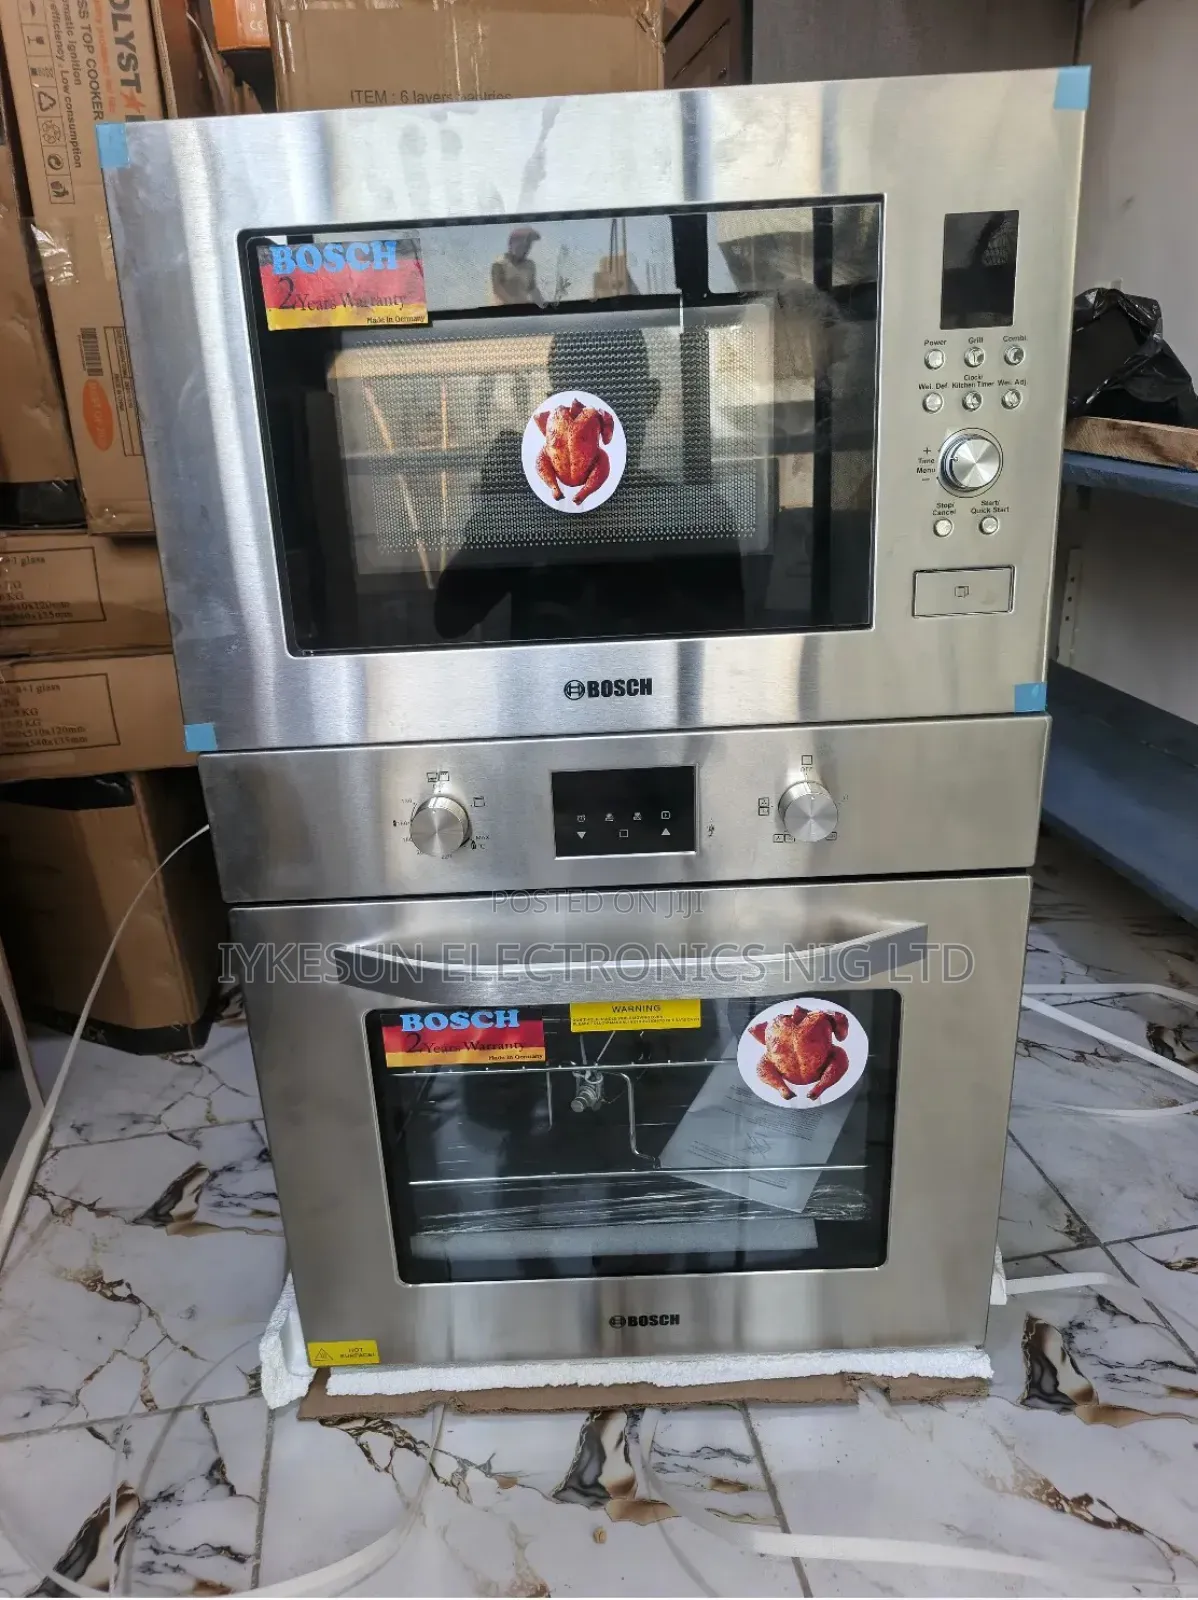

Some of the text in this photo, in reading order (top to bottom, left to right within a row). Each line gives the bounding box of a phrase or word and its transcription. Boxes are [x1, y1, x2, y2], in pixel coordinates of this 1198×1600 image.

[80, 24, 95, 54] TOP
[67, 40, 82, 86] Ignition
[50, 3, 82, 168] efficiency Low consumption
[86, 58, 104, 121] COOKER
[350, 90, 388, 104] ITEM
[400, 90, 409, 104] 6
[269, 240, 398, 275] BOSCH
[278, 277, 408, 311] 2 Years Warranty
[366, 316, 386, 324] Made
[394, 314, 426, 323] Germany
[923, 339, 947, 347] Power
[977, 380, 995, 388] Timer
[35, 682, 61, 695] glass
[586, 677, 653, 699] BOSCH
[22, 708, 39, 717] KG
[611, 1004, 662, 1014] WARNING
[400, 1009, 520, 1032] BOSCH
[405, 1032, 524, 1054] 2 Years Warranty
[627, 1314, 680, 1327] BOSCH
